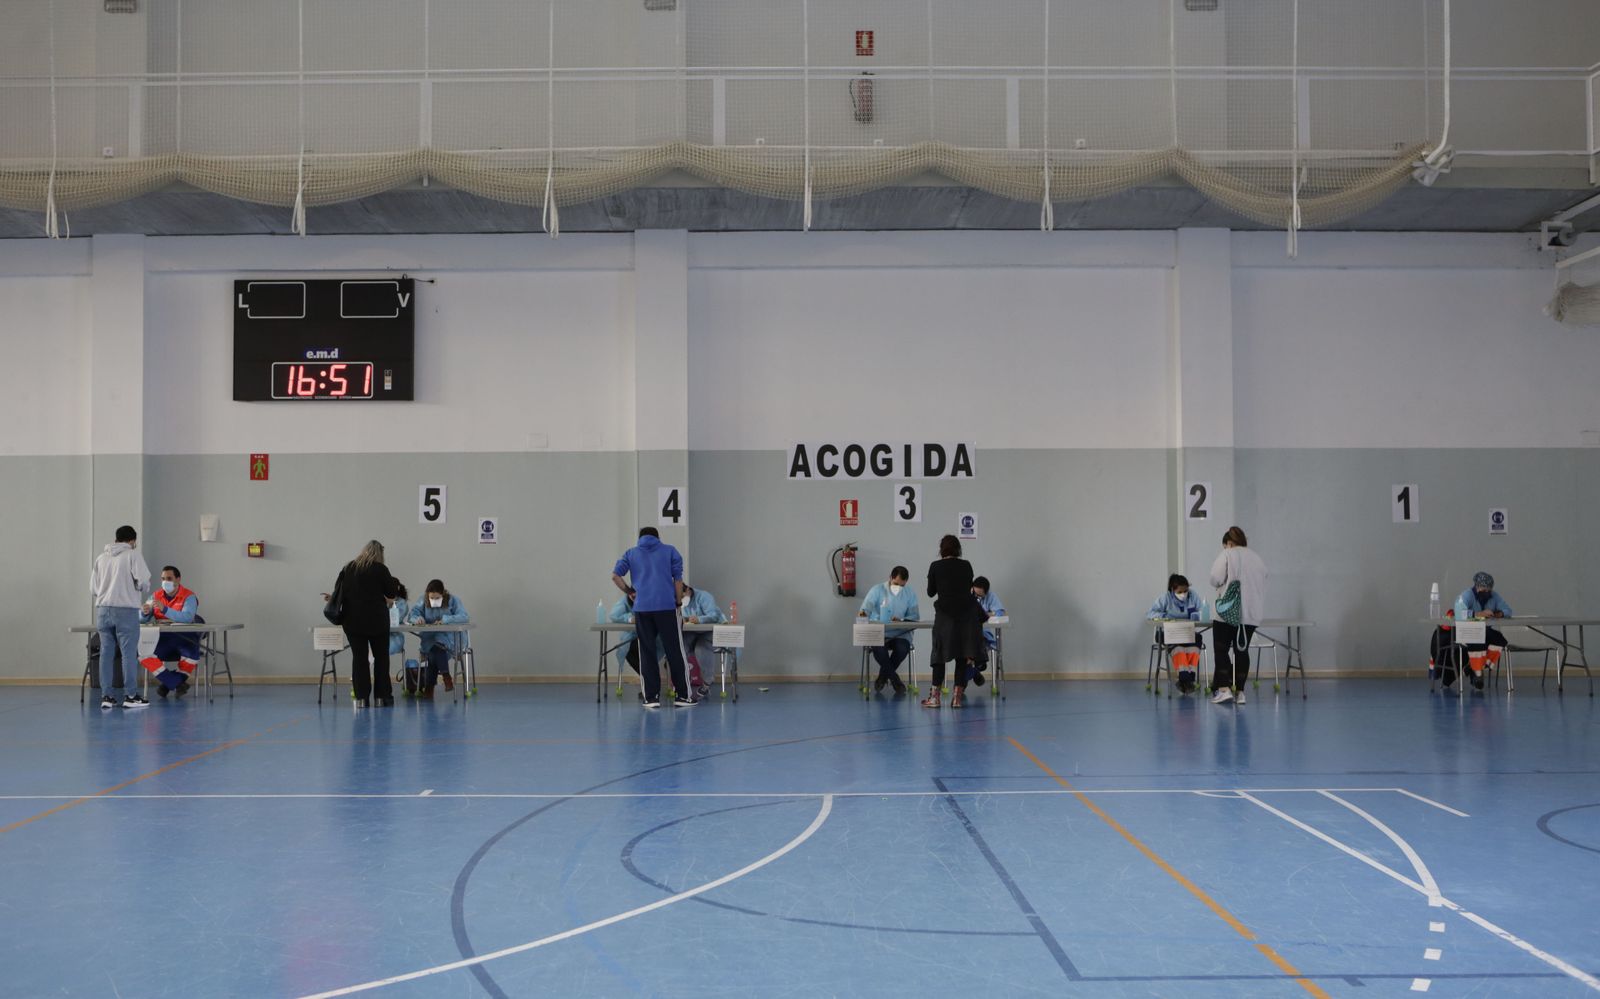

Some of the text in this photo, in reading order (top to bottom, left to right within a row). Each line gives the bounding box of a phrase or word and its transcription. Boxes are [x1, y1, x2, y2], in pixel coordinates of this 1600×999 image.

[238, 293, 249, 308] L
[398, 293, 410, 307] V
[306, 348, 339, 359] e.m.d
[287, 364, 371, 395] 16:51
[789, 443, 973, 477] ACOGIDA
[423, 488, 441, 521] 5
[661, 489, 681, 523] 4
[898, 486, 917, 520] 3
[1189, 484, 1207, 518] 2
[1397, 486, 1411, 520] 1
